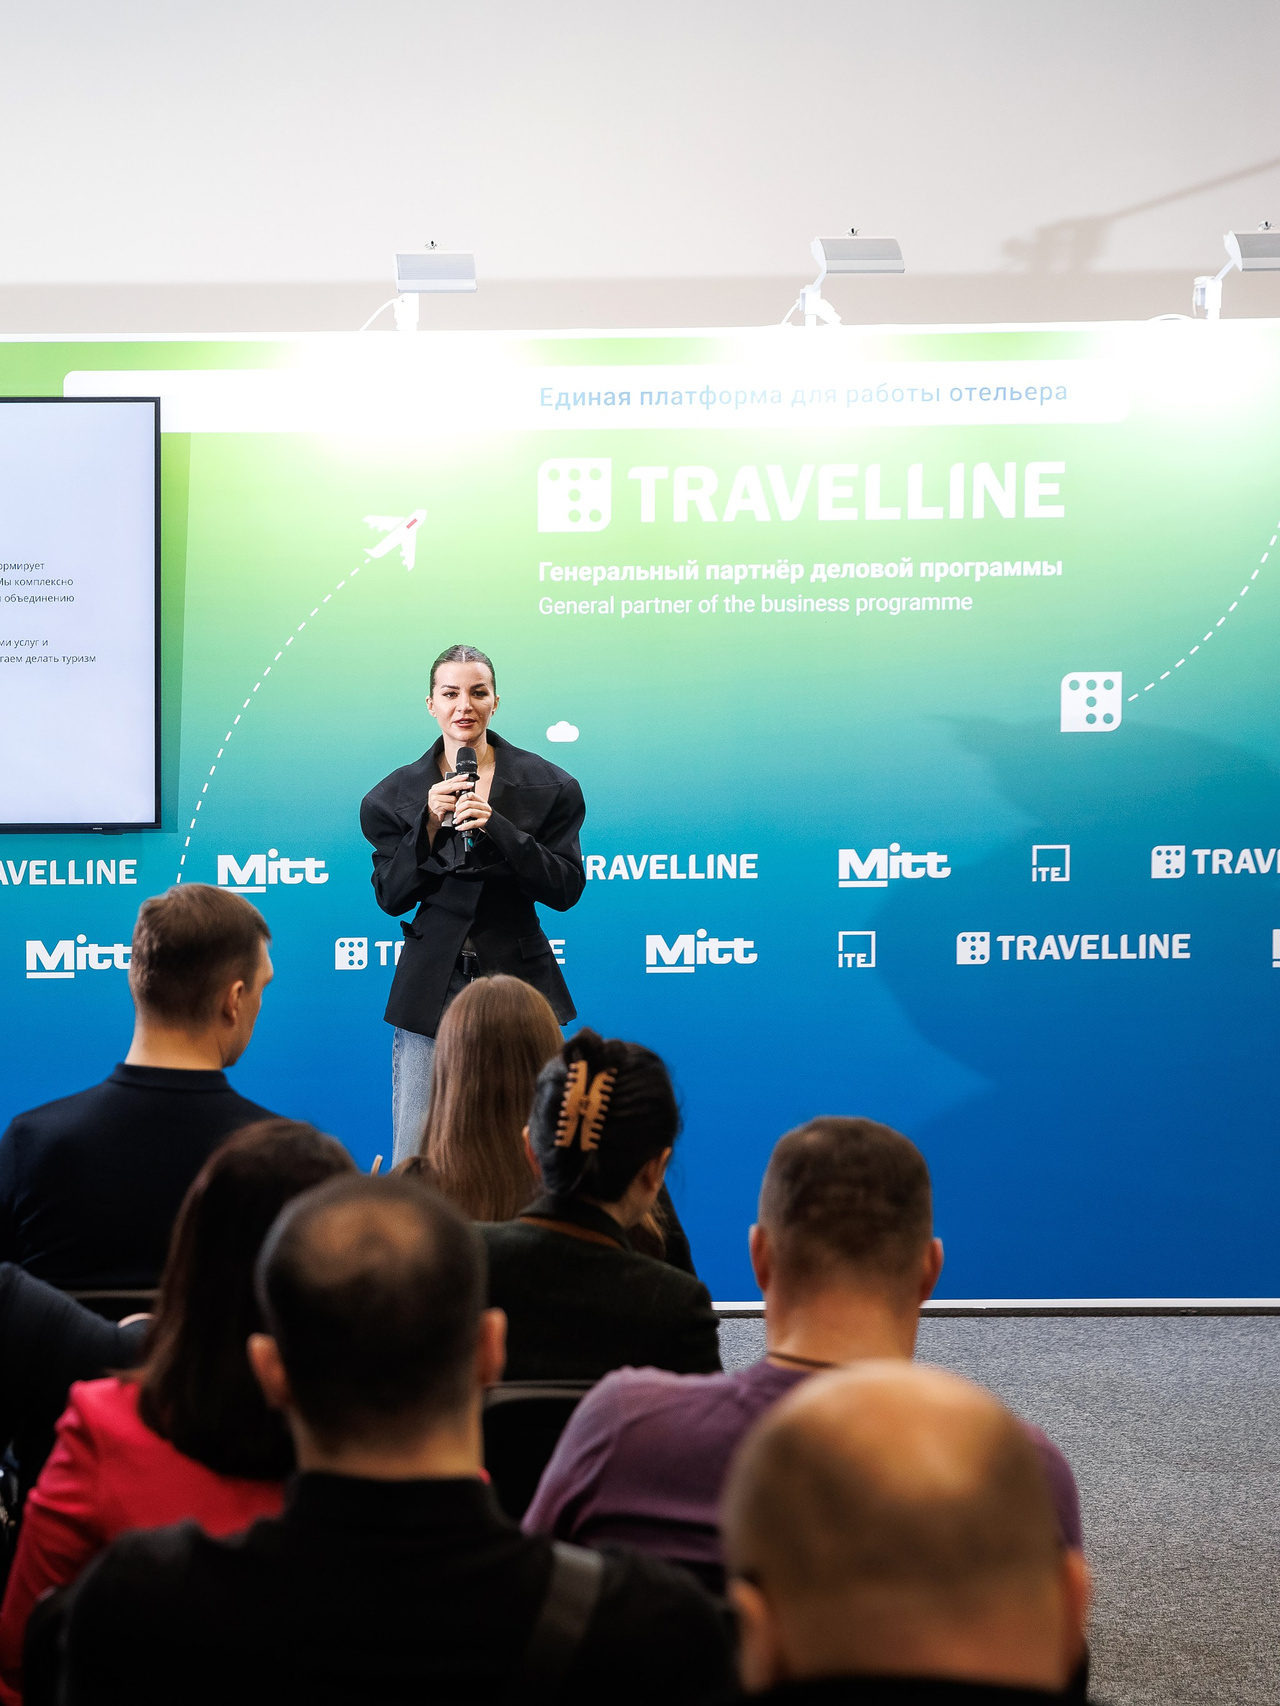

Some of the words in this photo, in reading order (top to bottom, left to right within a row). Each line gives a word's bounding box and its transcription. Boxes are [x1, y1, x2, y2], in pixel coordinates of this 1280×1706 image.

[540, 387, 631, 411] Единая
[640, 385, 783, 410] платформа
[791, 389, 837, 409] для
[846, 383, 941, 408] работы
[949, 383, 1068, 407] отельера
[627, 461, 1066, 523] TRAVELLINE
[14, 578, 74, 586] комплексно
[538, 560, 699, 583] Генеральный
[706, 558, 804, 584] партнёр
[811, 557, 913, 583] деловой
[920, 559, 1063, 583] программы
[4, 594, 75, 604] объединению
[539, 595, 615, 615] General
[621, 596, 692, 618] partner
[698, 594, 719, 614] of
[723, 594, 756, 613] the
[761, 593, 850, 613] business
[855, 594, 973, 616] programme
[14, 639, 40, 648] услуг
[42, 639, 49, 647] и
[25, 655, 60, 665] делать
[62, 655, 97, 666] туризм
[217, 848, 329, 885] Mitt
[838, 842, 952, 880] Mitt
[1191, 848, 1280, 874] TRAV
[25, 934, 133, 970] Mitt
[645, 928, 758, 965] Mitt
[996, 933, 1191, 961] TRAVELLINE
